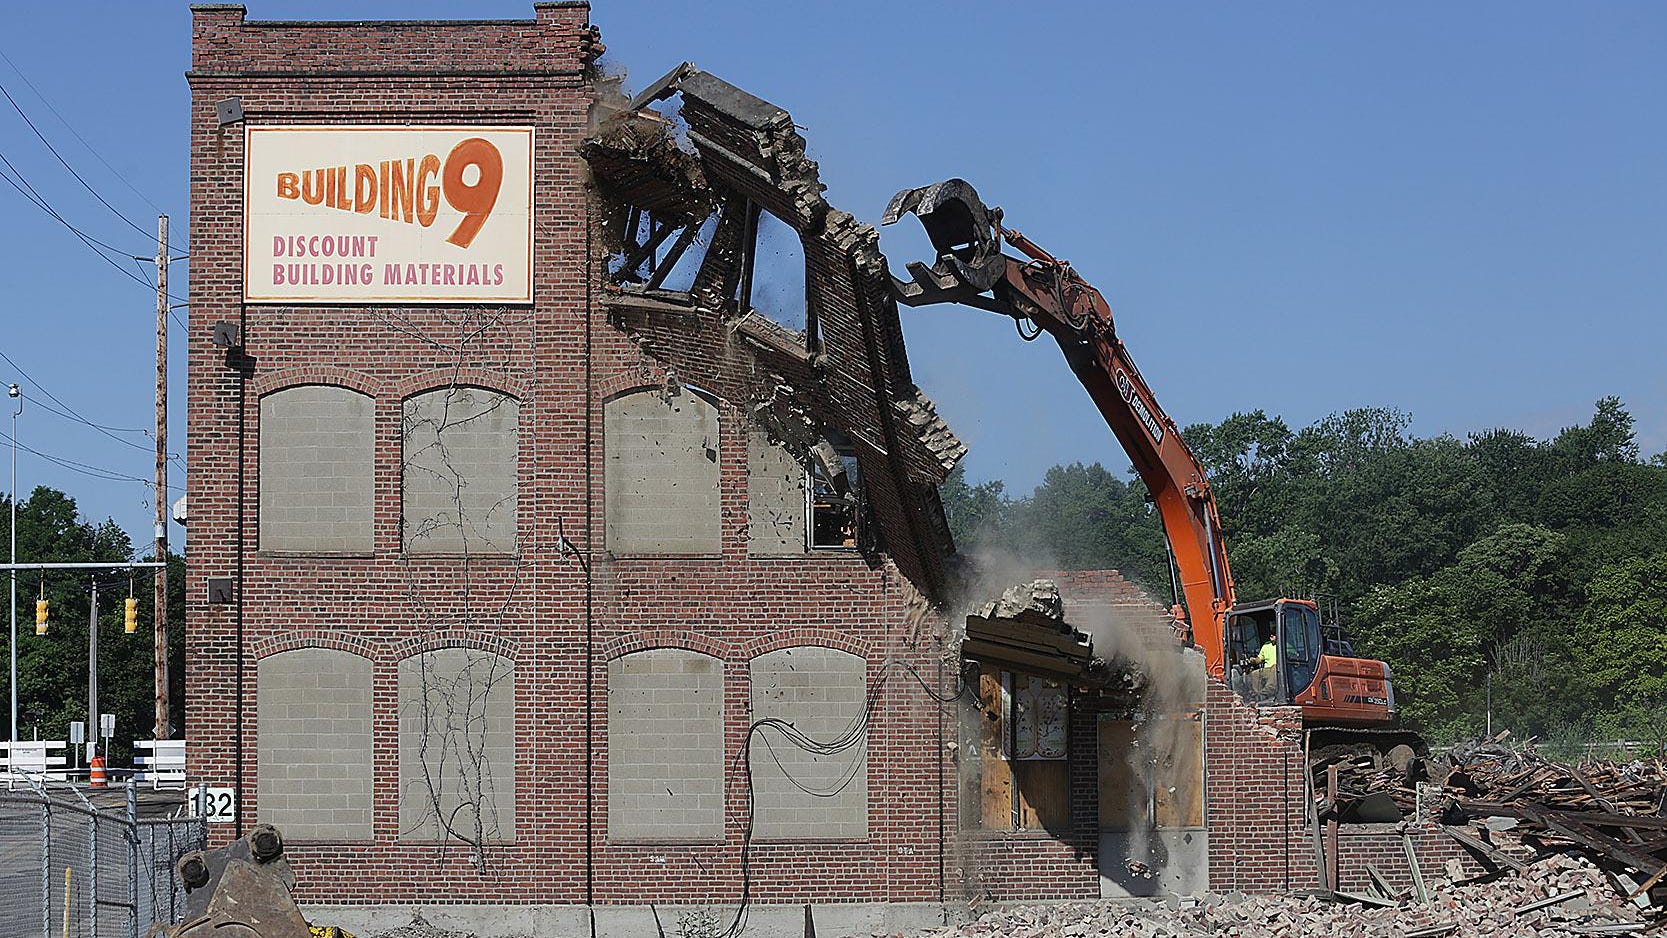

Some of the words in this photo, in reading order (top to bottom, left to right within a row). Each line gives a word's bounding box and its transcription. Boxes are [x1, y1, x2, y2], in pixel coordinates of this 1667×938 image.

[277, 154, 441, 227] BUILDING
[442, 137, 504, 249] 9
[273, 236, 378, 257] DISCOUNT
[273, 264, 373, 285] BUILDING
[384, 264, 504, 285] MATERIALS
[1132, 396, 1163, 442] DEMOLITION
[190, 792, 232, 817] 132
